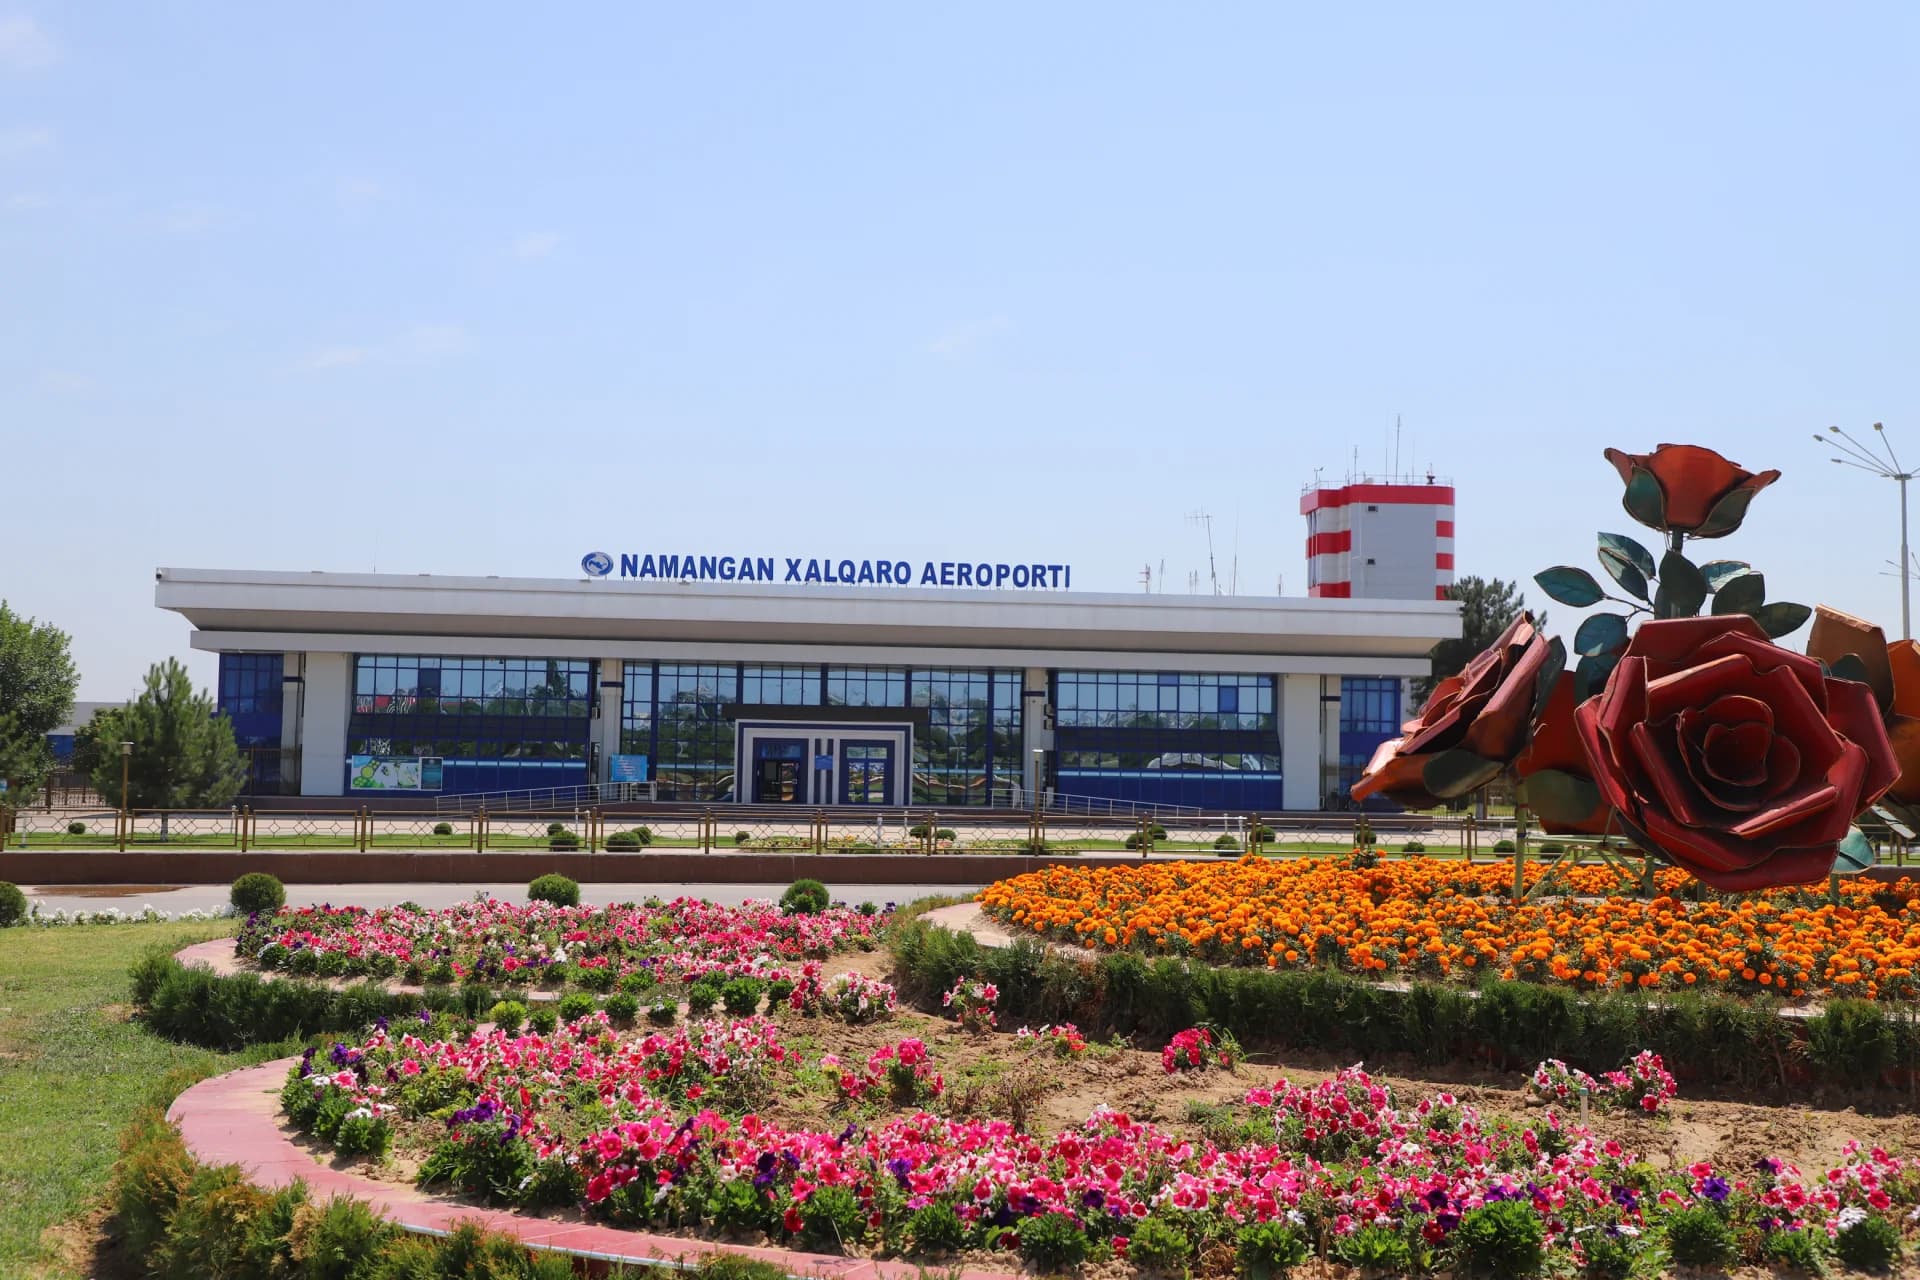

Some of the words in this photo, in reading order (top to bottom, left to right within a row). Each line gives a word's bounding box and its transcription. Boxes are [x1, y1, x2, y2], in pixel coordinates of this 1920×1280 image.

[620, 553, 774, 582] NAMANGAN
[784, 558, 912, 585] XALQARO
[920, 561, 1071, 588] AEROPORTI
